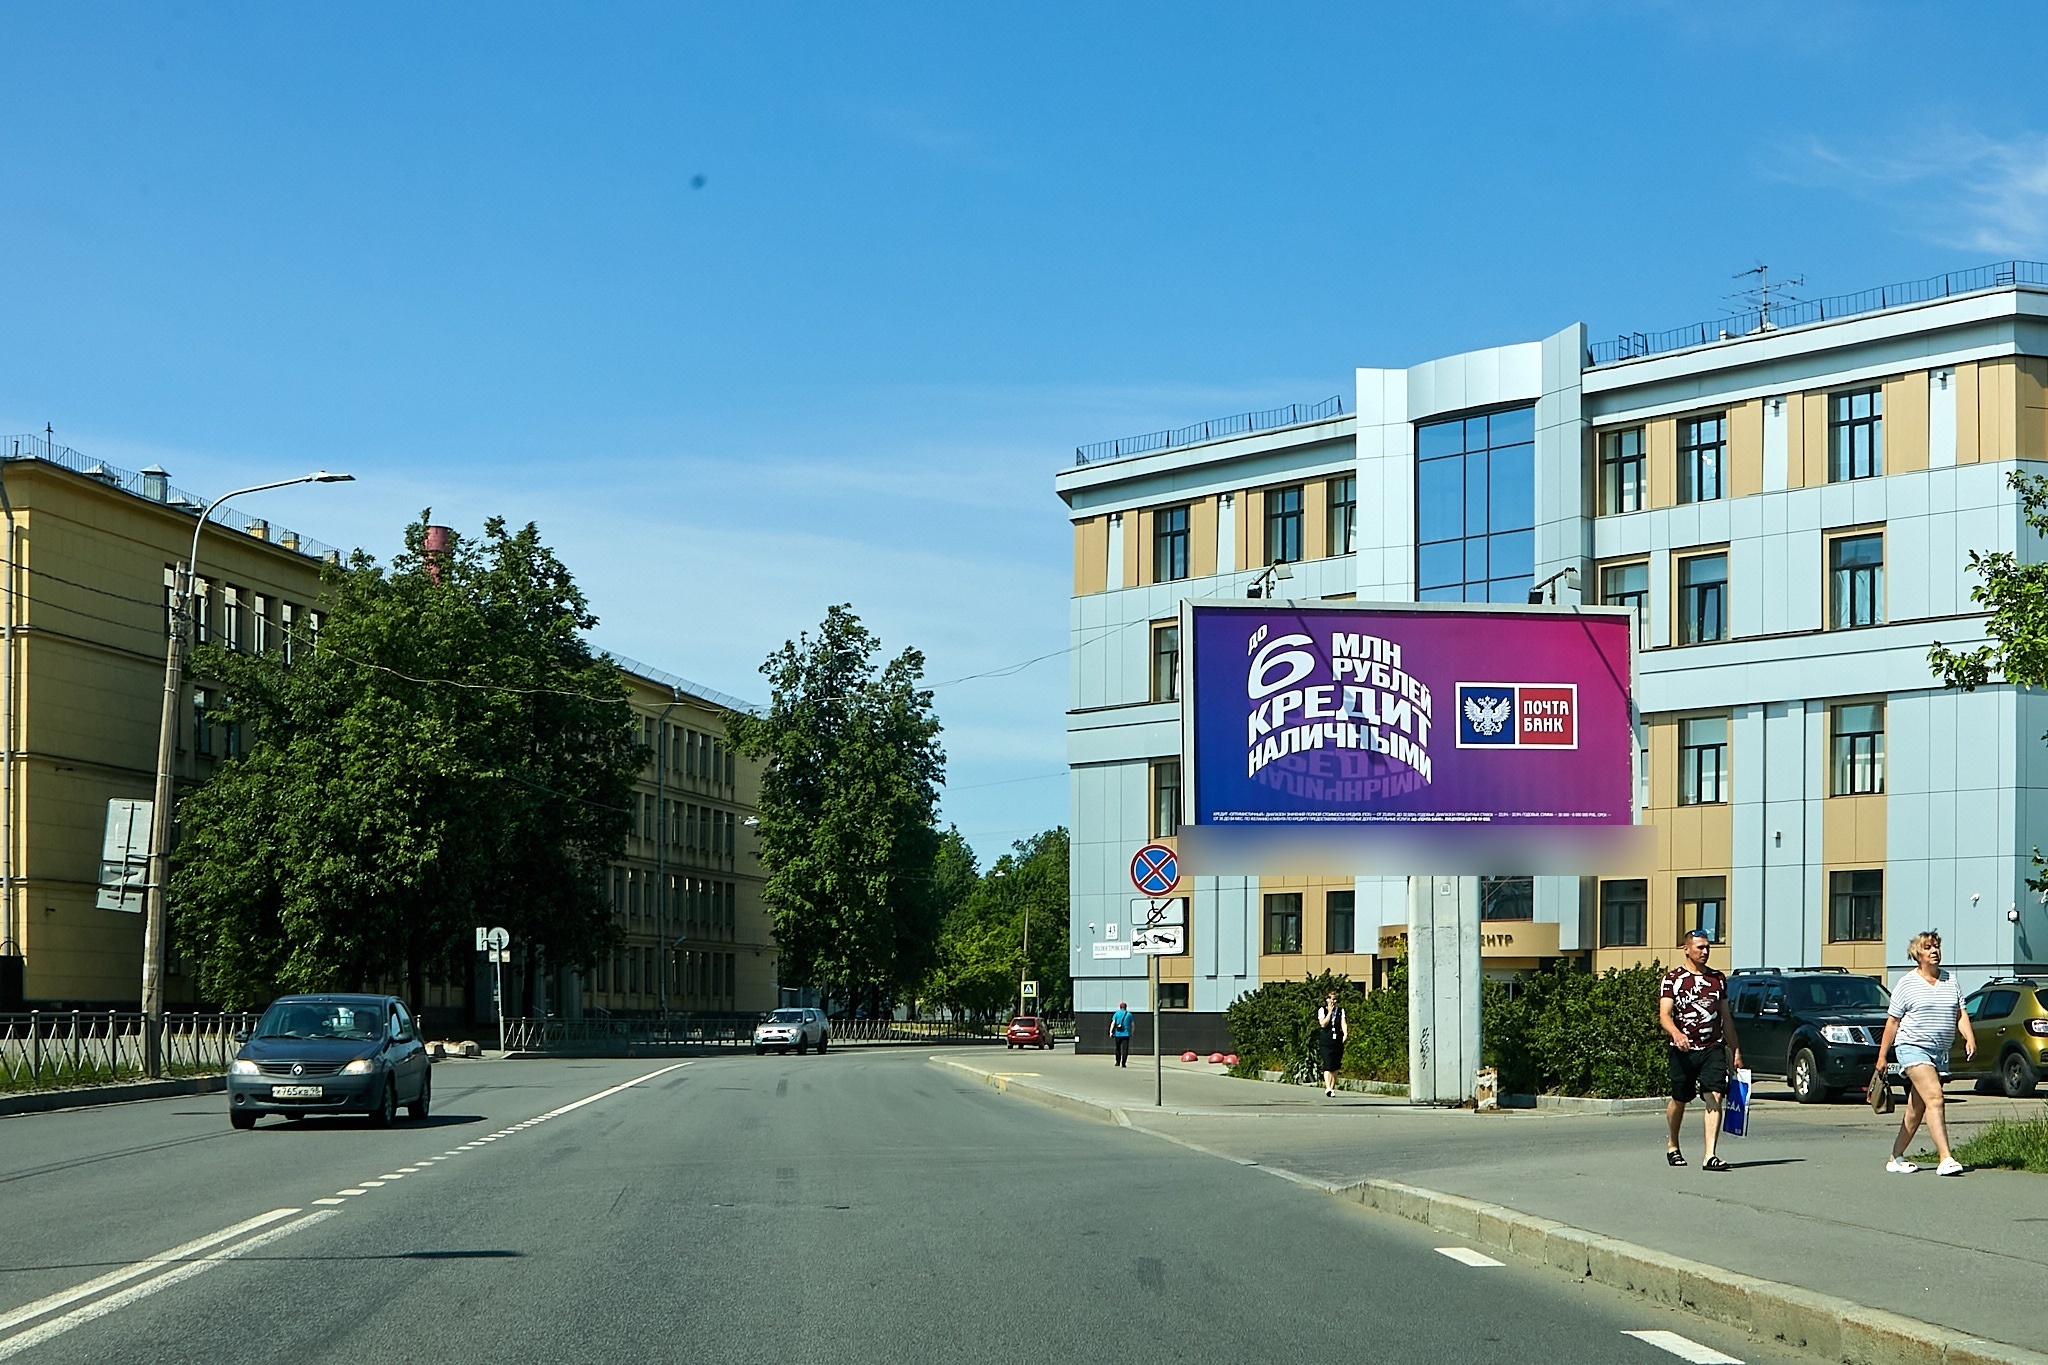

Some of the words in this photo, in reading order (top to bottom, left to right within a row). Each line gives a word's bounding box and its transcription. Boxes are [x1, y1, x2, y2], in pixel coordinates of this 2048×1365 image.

[1248, 624, 1268, 656] ДО
[1332, 632, 1401, 669] МЛН
[1247, 634, 1316, 699] 6
[1332, 657, 1432, 719] РУБЛЕЙ
[1248, 684, 1432, 748] КРЕДИТ
[1523, 700, 1569, 715] ПОЧТА
[1523, 717, 1564, 732] БАНК
[1248, 722, 1432, 785] НАЛИЧНЫМИ
